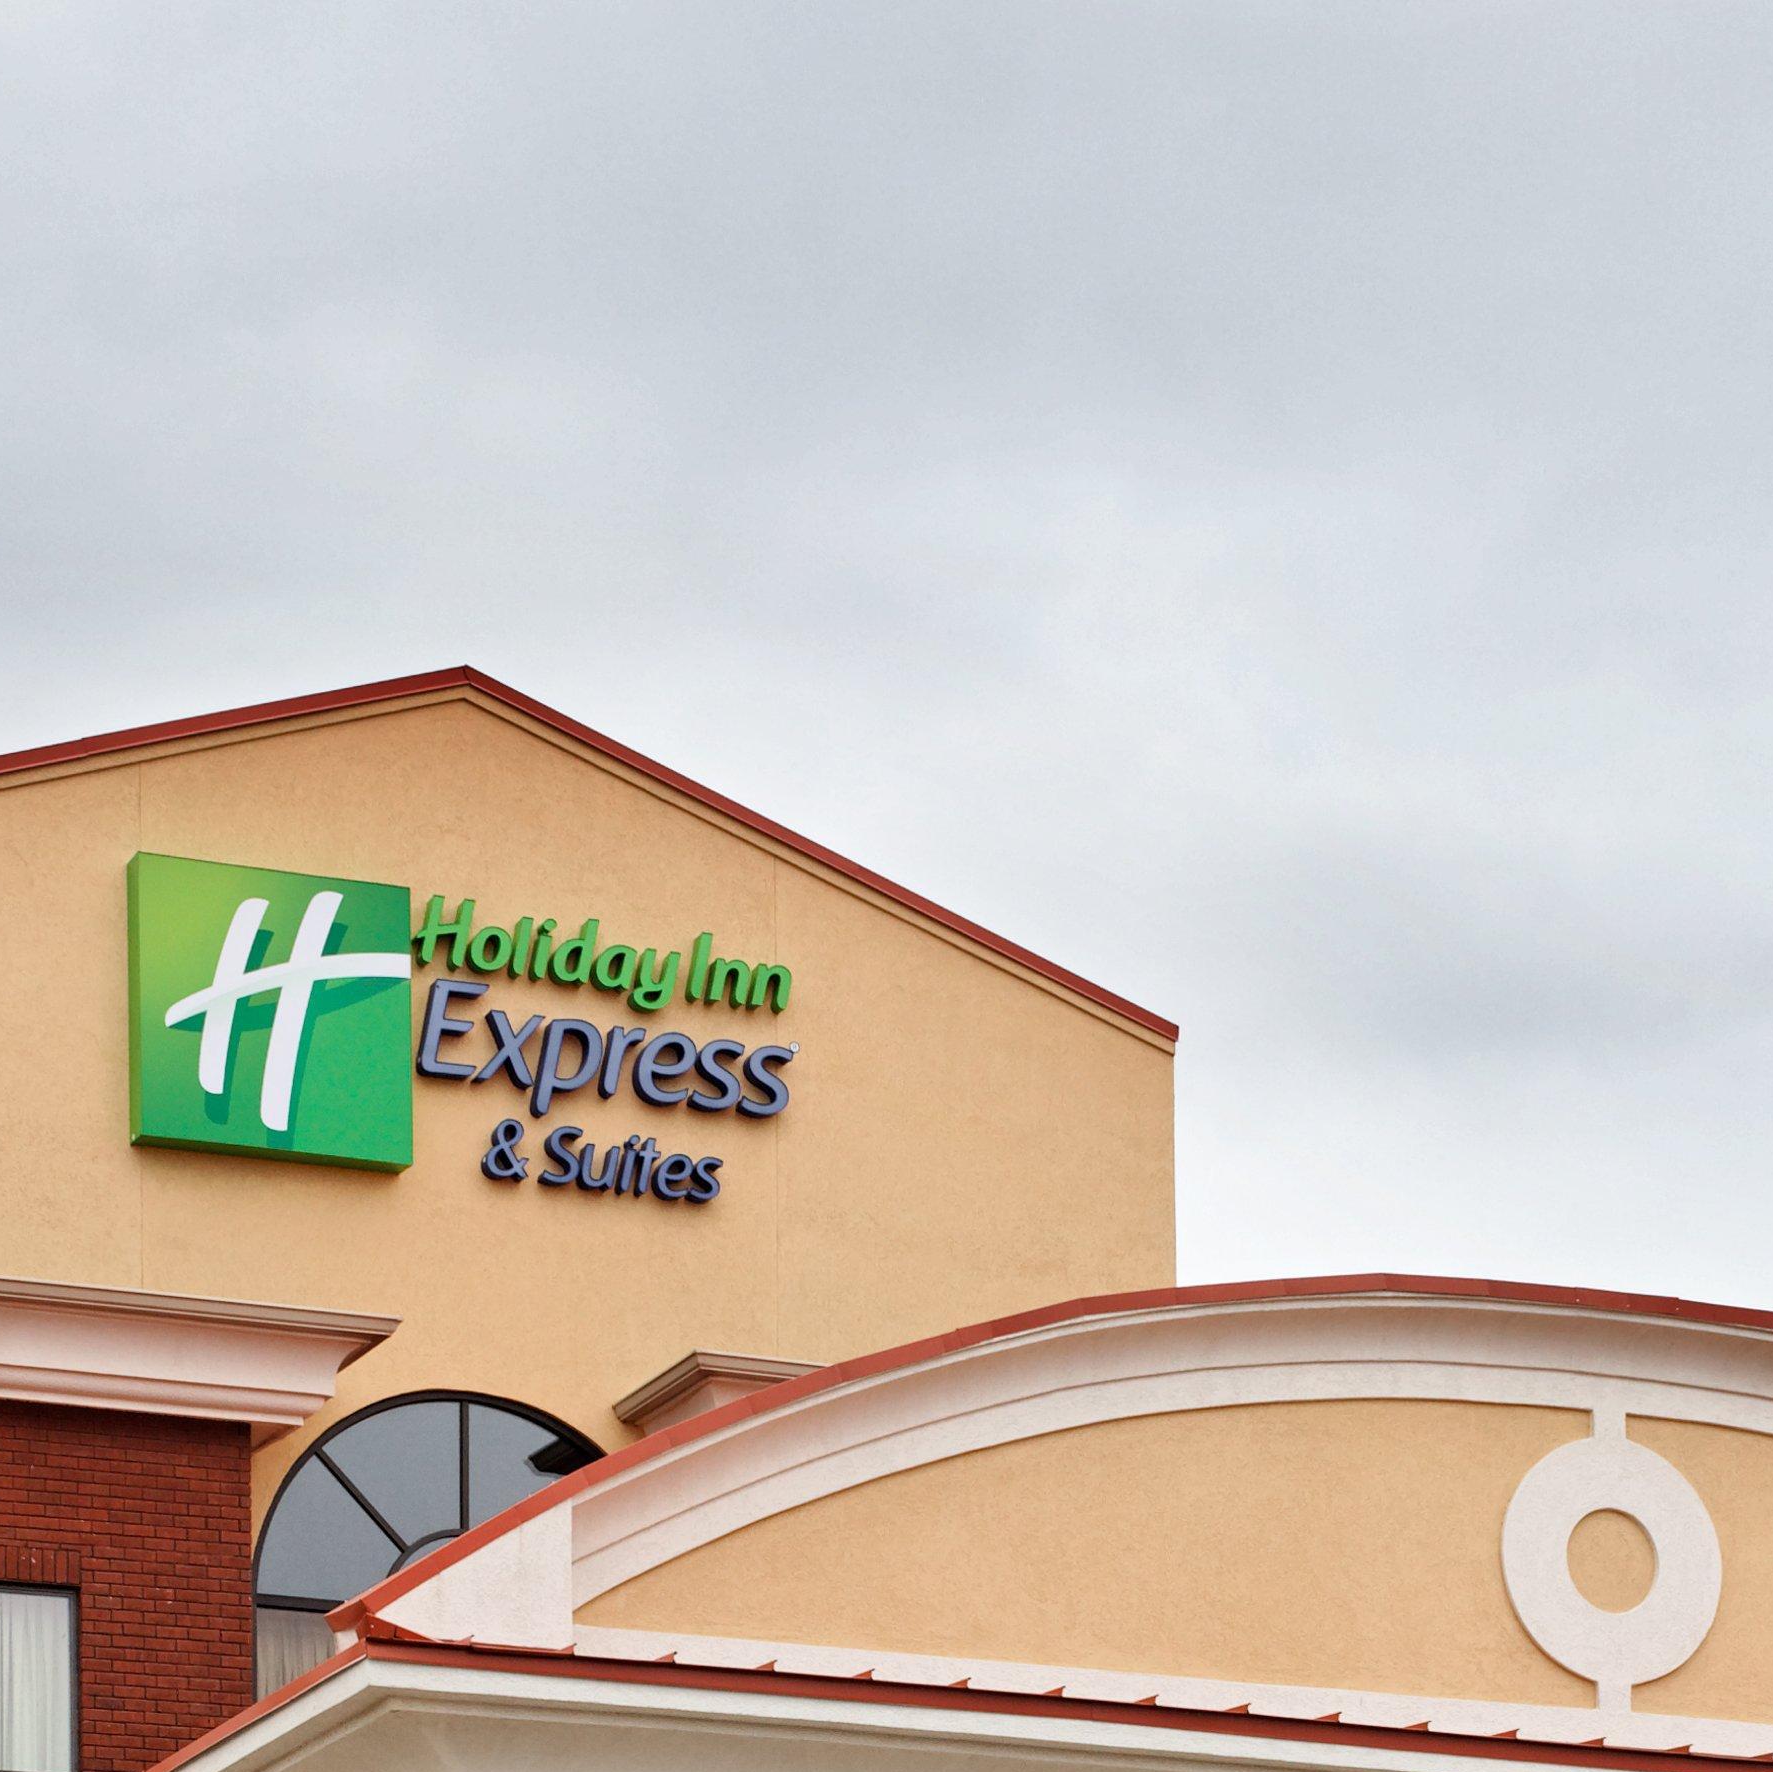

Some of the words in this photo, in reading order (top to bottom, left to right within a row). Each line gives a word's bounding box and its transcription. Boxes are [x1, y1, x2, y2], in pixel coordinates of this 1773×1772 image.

[413, 894, 681, 1013] Holiday
[684, 931, 793, 1014] Inn
[481, 1118, 529, 1181] &
[538, 1125, 725, 1203] Suites
